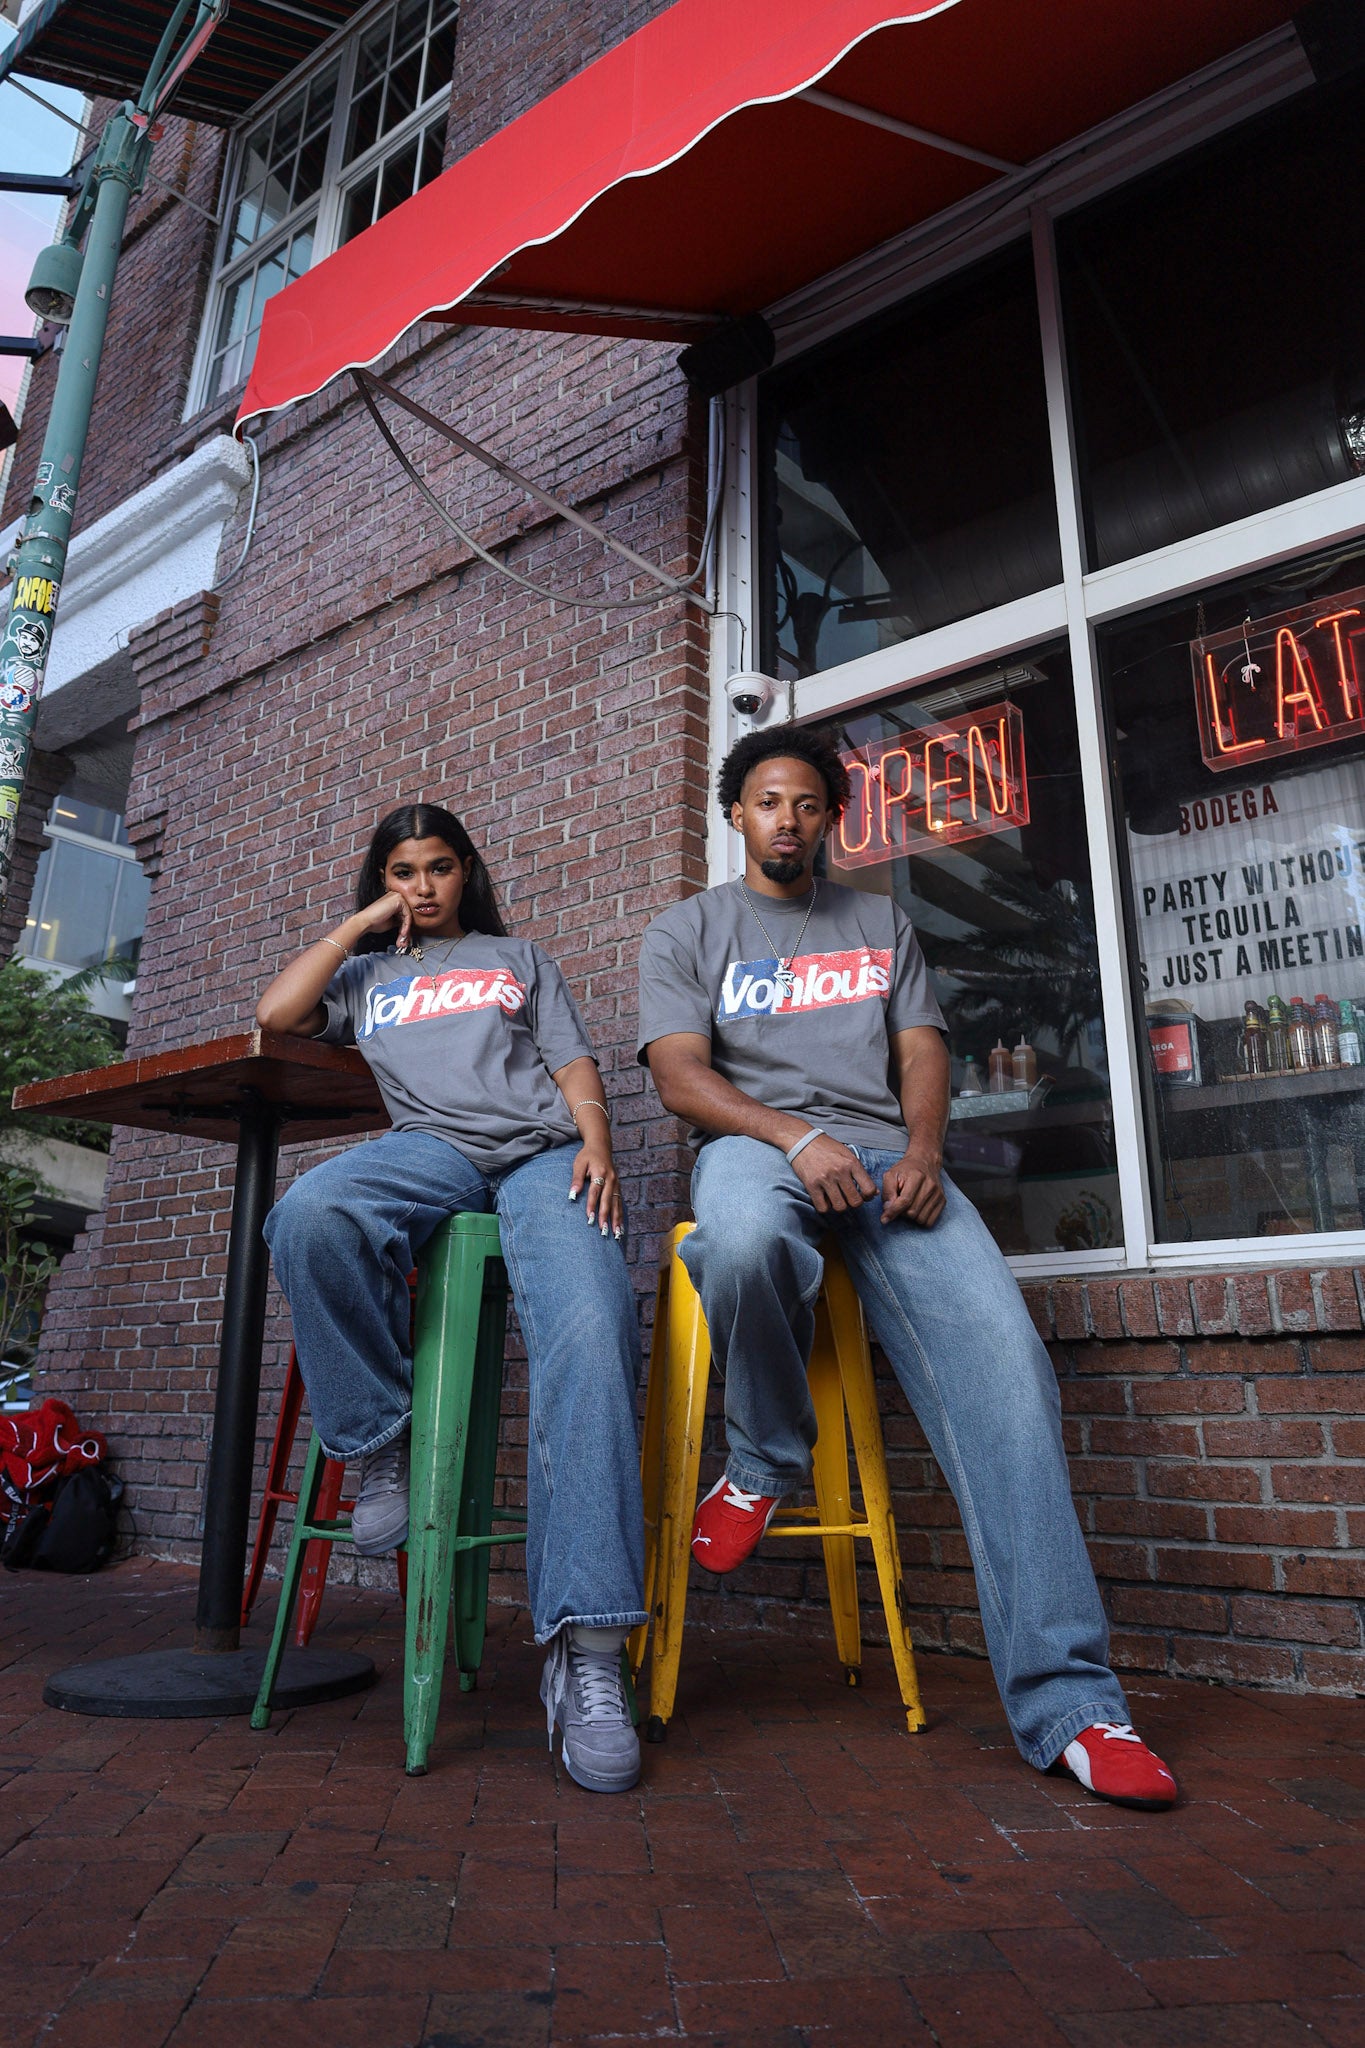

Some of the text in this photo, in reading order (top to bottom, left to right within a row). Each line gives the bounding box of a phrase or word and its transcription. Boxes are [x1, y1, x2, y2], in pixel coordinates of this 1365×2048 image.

[840, 718, 1008, 852] OPEN
[1178, 785, 1280, 836] BODEGA
[1143, 841, 1365, 916] PARTY WITHOUT
[1182, 896, 1300, 945] TEQUILA
[1163, 949, 1223, 988] JUST
[1236, 944, 1252, 976] A
